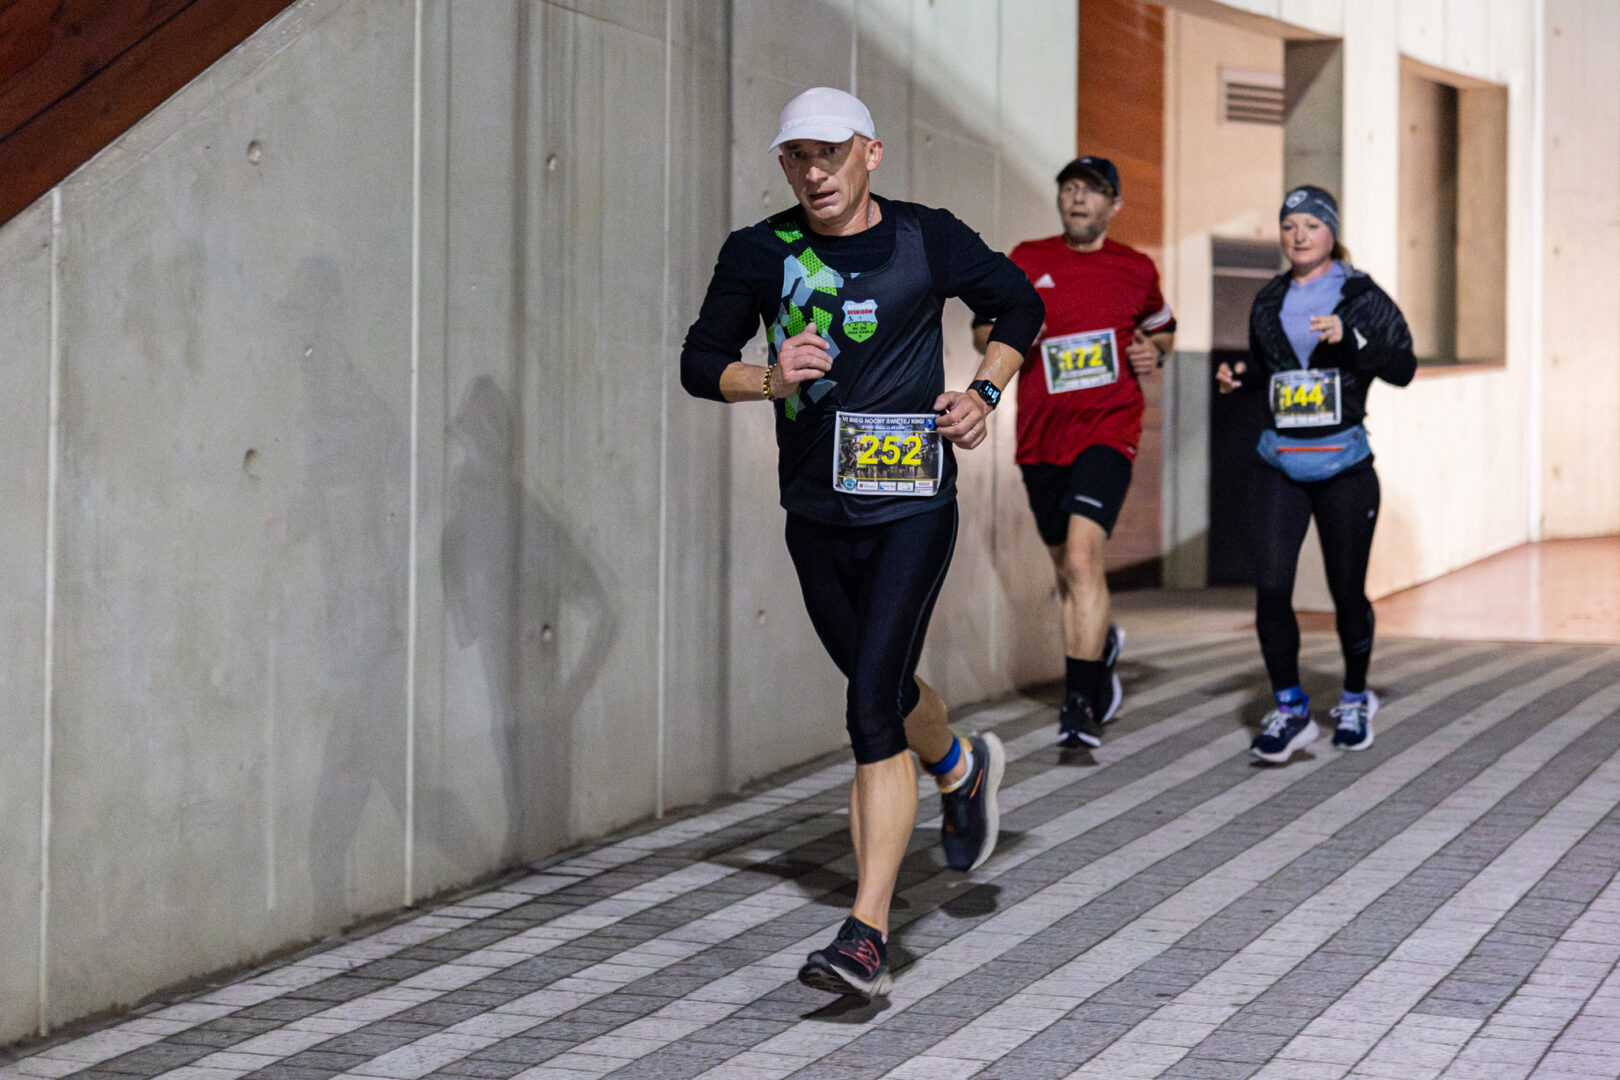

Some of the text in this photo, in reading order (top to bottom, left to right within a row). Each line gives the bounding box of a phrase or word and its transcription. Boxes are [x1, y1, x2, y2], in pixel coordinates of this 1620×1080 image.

[1063, 343, 1104, 371] 172
[1284, 380, 1324, 407] 144
[858, 435, 922, 465] 252
